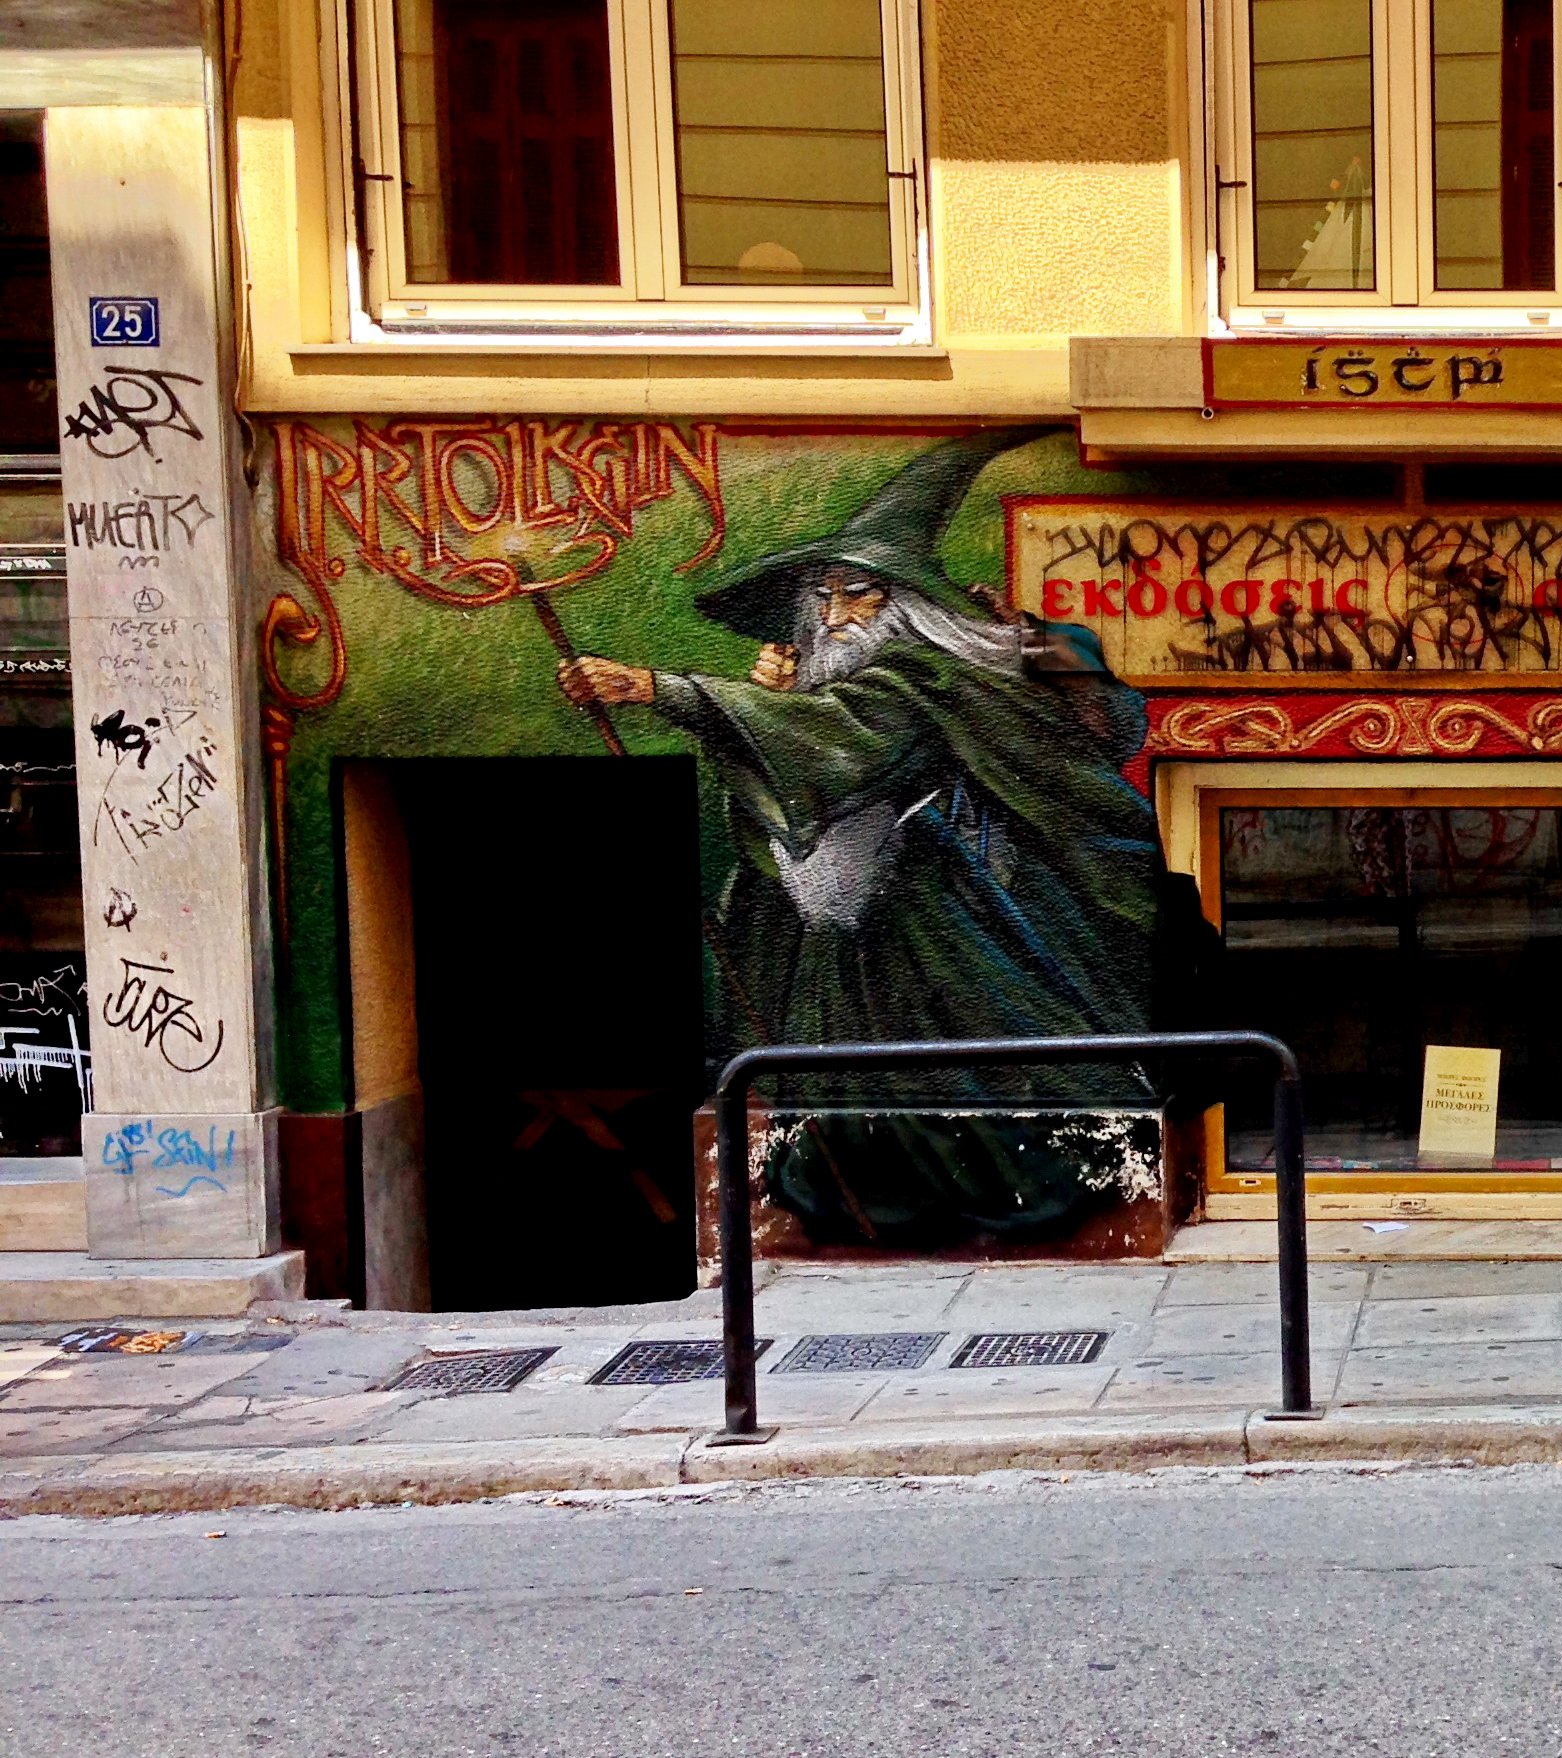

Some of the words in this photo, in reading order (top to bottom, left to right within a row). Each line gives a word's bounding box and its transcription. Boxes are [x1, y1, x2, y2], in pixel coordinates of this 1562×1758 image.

[100, 304, 144, 338] 25
[1041, 557, 1369, 632] εκδόσεις
[1435, 1088, 1485, 1100] ΜΕΓΑΛΕΣ
[1426, 1100, 1491, 1113] ΠΡΟΣΦΟΡΕΣ
